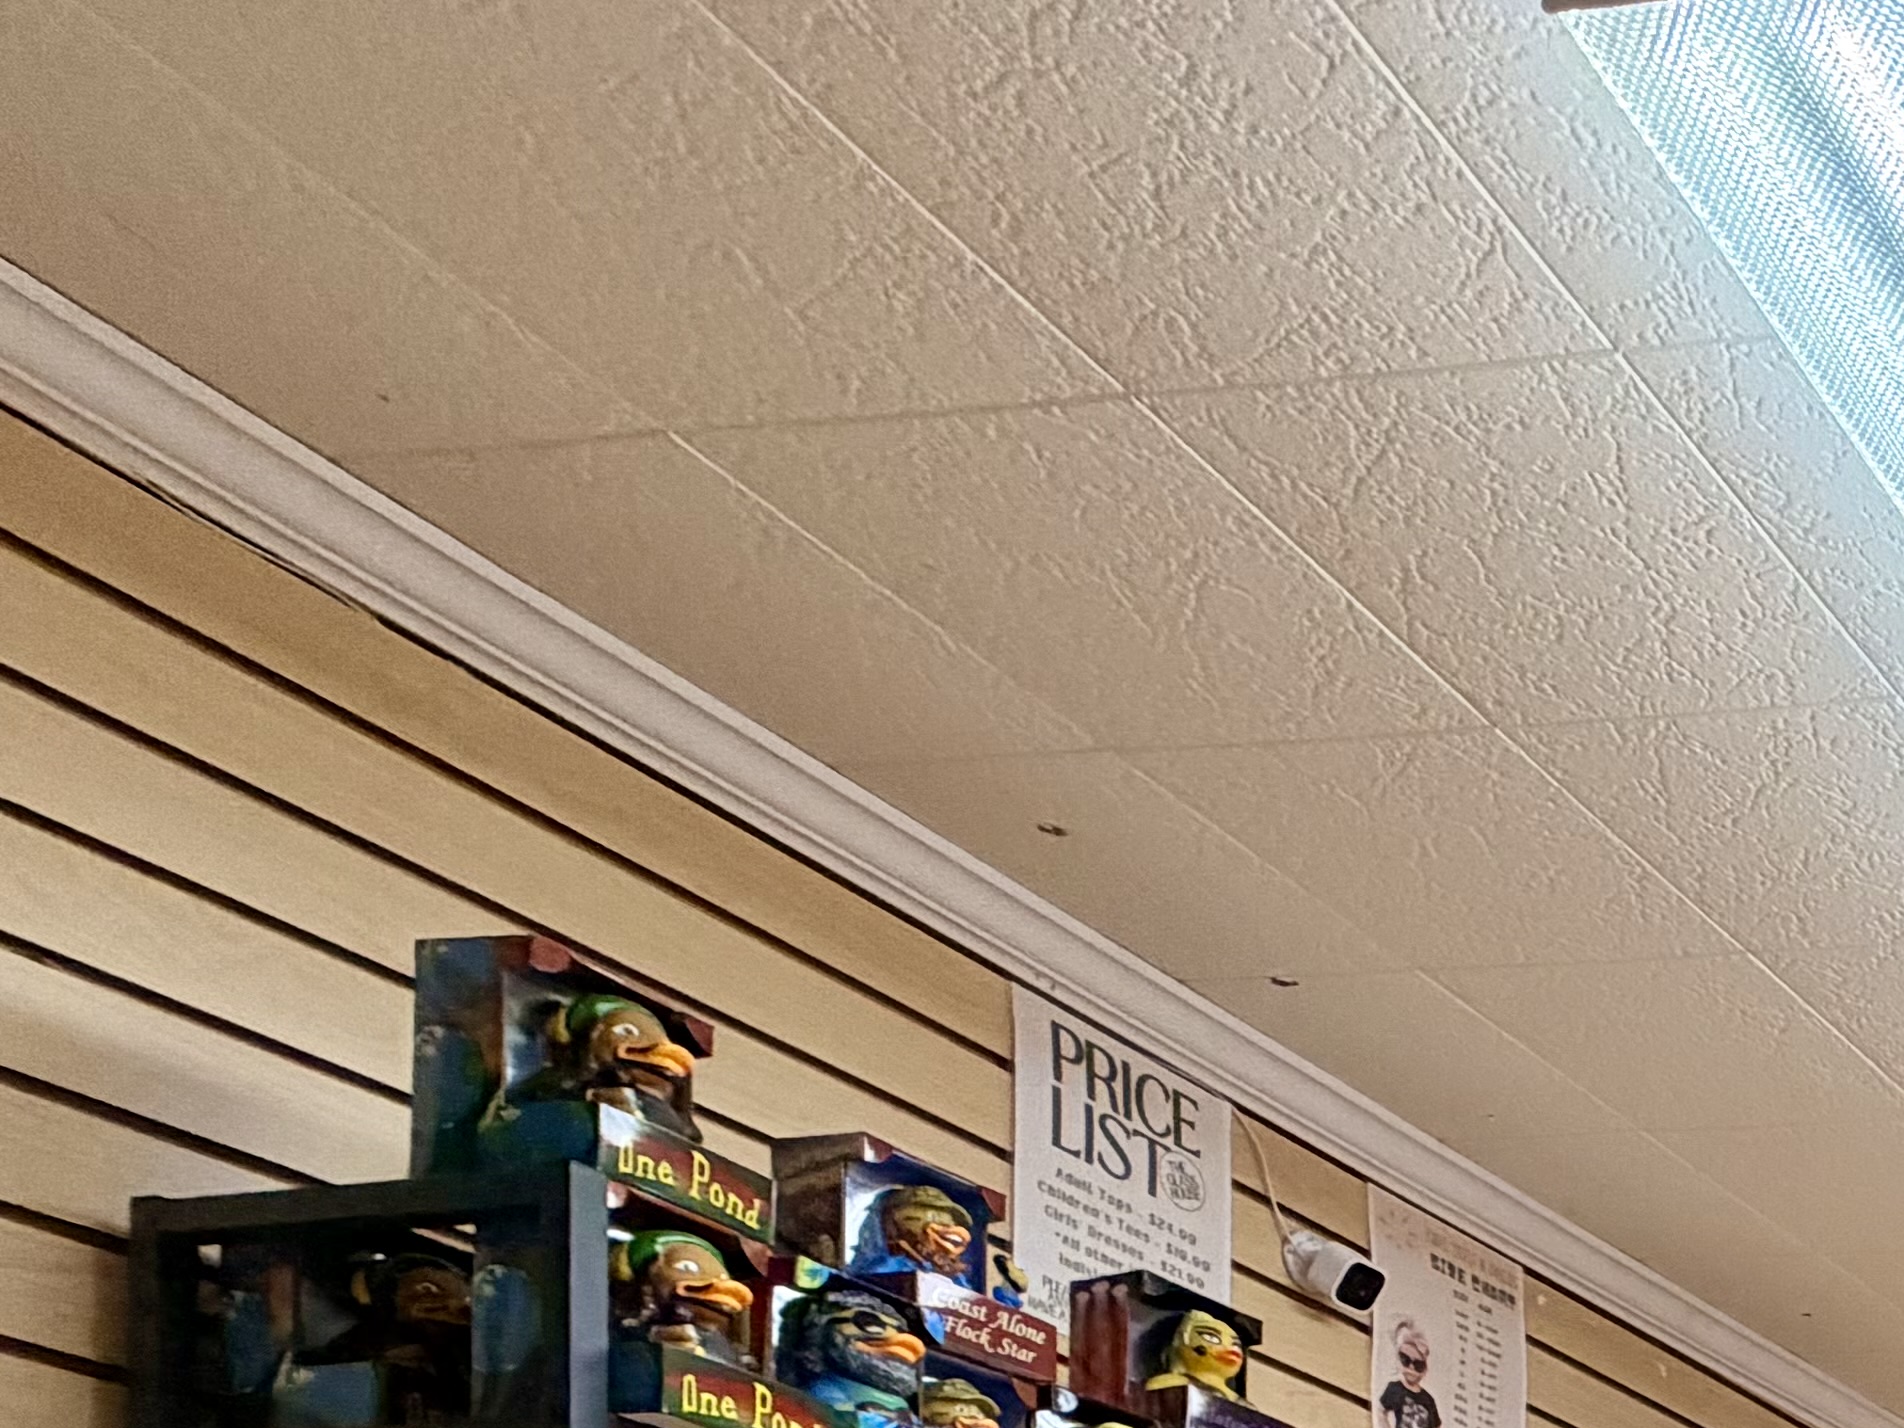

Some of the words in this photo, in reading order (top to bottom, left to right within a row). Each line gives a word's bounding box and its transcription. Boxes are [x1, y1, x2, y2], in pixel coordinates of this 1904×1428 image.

[1051, 1020, 1201, 1158] PRICE
[1051, 1085, 1172, 1198] LIST
[618, 1141, 675, 1186] One
[689, 1150, 760, 1230] Pond
[944, 1317, 996, 1354] Flock
[997, 1337, 1038, 1363] Star
[988, 1310, 1046, 1345] Alone
[682, 1374, 738, 1420] One
